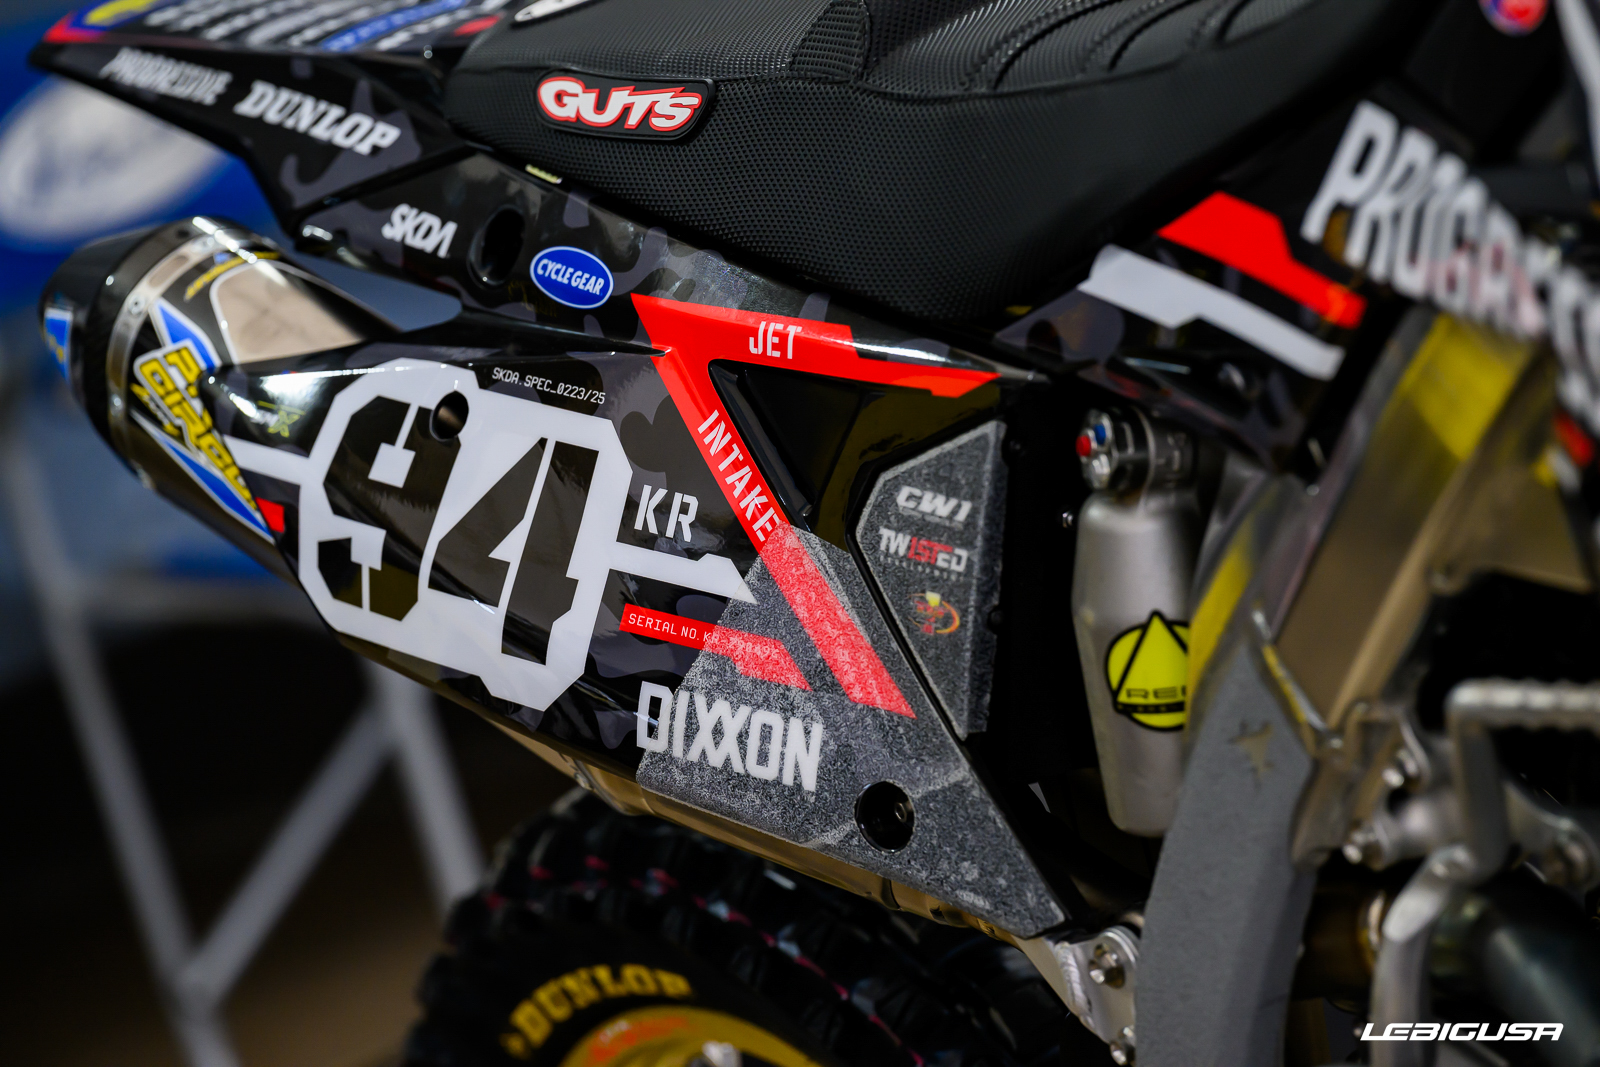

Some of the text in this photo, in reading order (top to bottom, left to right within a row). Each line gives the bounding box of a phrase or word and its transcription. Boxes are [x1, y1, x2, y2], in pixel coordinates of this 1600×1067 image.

[234, 80, 401, 156] DUNLOP
[537, 76, 703, 131] GUTS
[381, 204, 457, 258] SKDA
[537, 258, 605, 295] CYCLE GEAR
[749, 321, 802, 360] JET
[492, 367, 606, 404] SKDA.SPEC_0223/25
[697, 409, 782, 542] INTAKE
[318, 395, 599, 666] 94
[634, 484, 699, 543] KR
[879, 526, 968, 572] TWISTED
[628, 613, 677, 635] SERIAL
[680, 625, 700, 641] NO.
[637, 681, 823, 792] DIXXON
[510, 963, 692, 1049] DUNLOP
